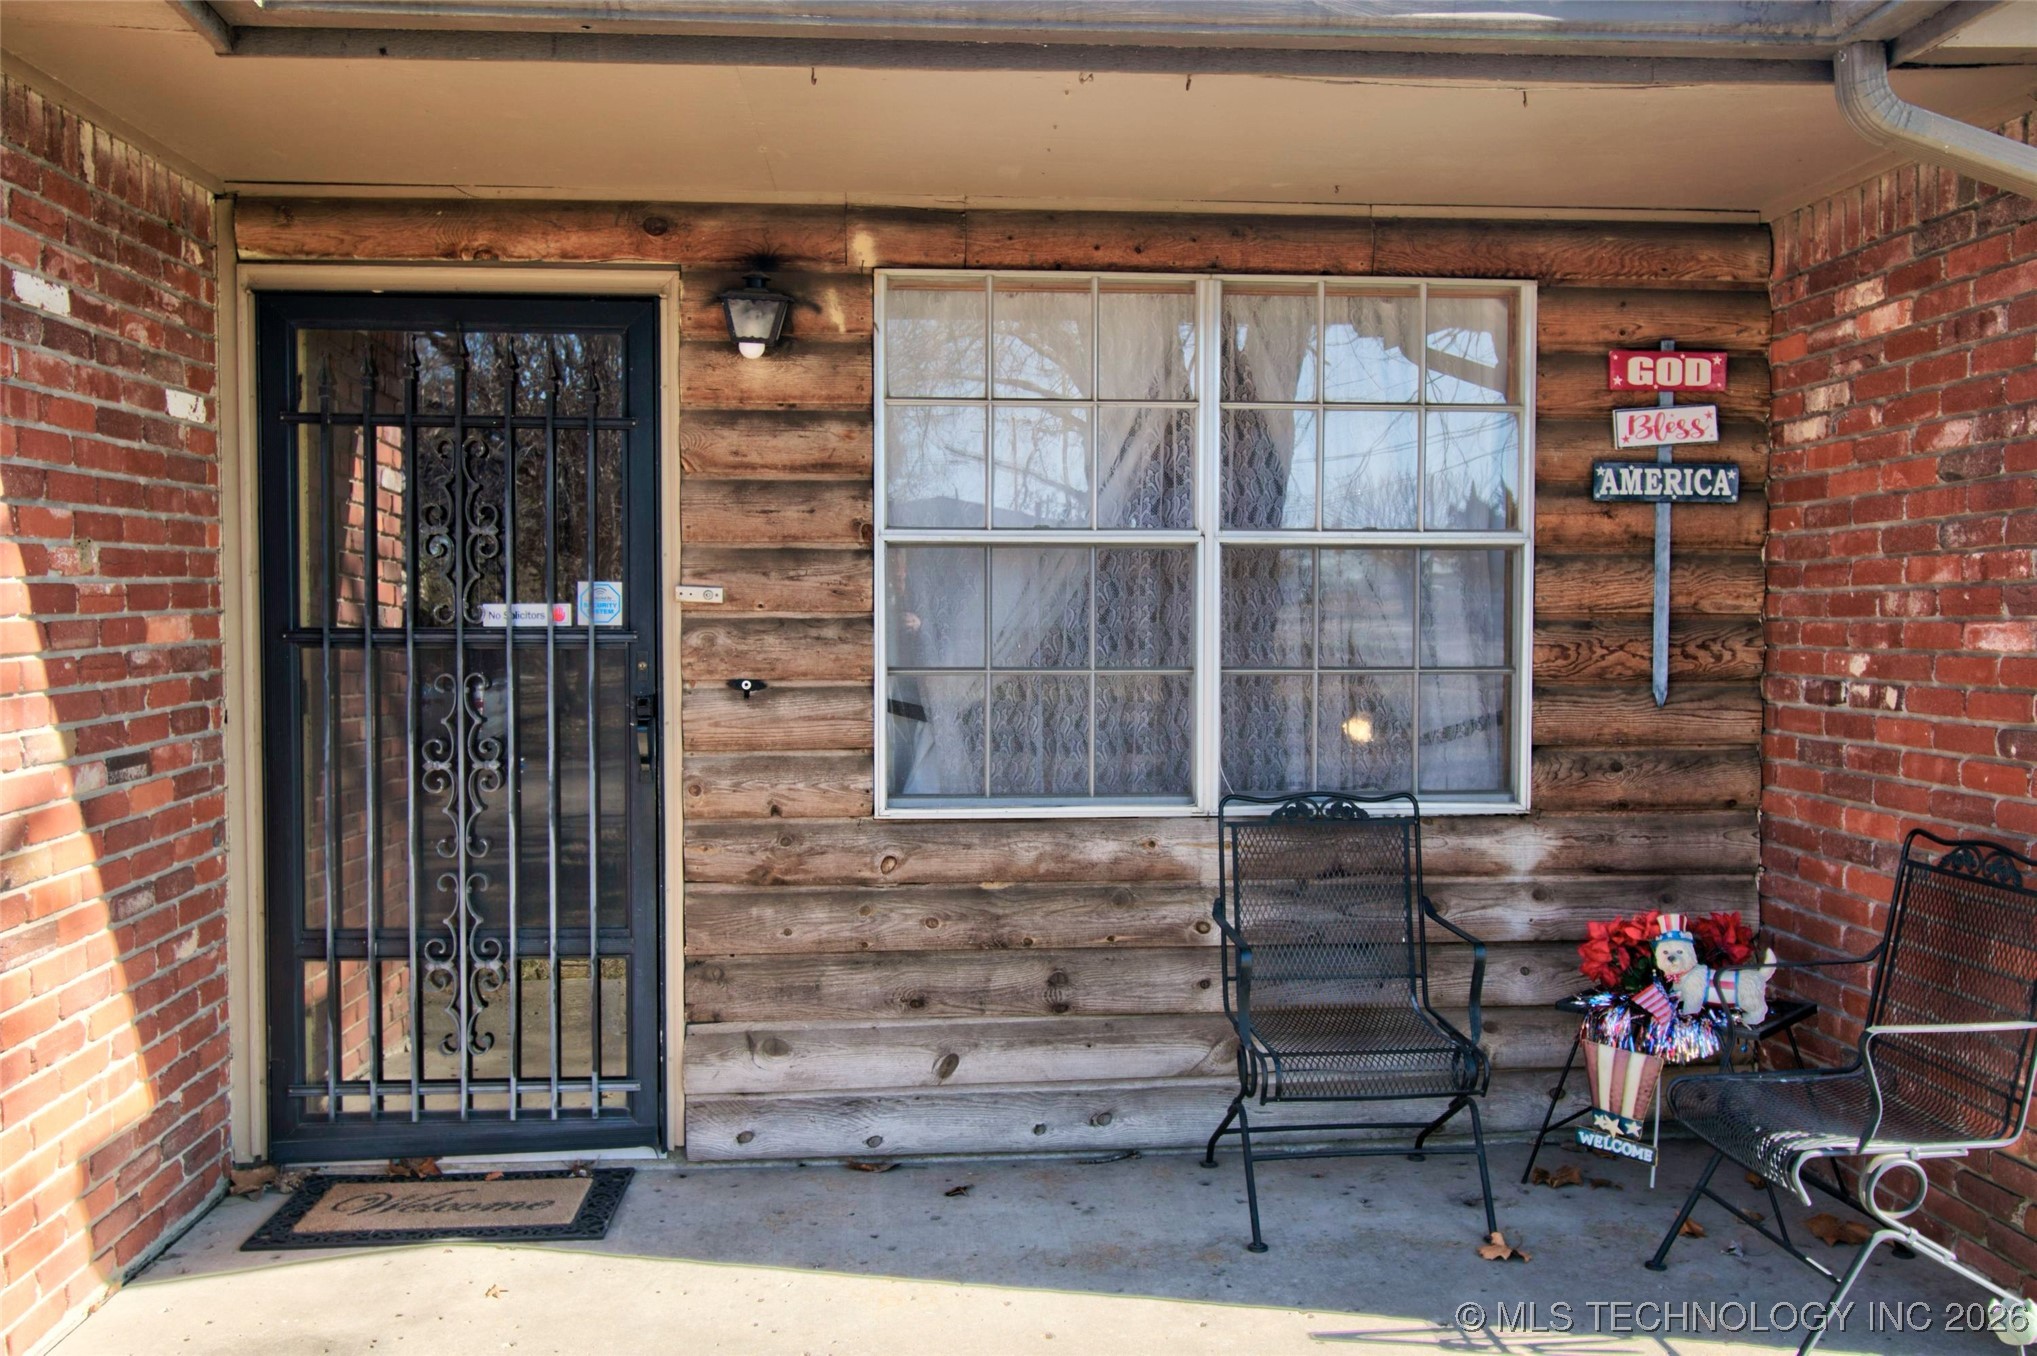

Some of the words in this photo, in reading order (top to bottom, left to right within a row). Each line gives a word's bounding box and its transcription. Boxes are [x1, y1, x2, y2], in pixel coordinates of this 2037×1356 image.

[1627, 356, 1712, 387] GOD
[1628, 411, 1710, 442] Bless
[1599, 467, 1732, 496] AMERICA
[488, 611, 502, 620] No
[1578, 1131, 1654, 1163] WELCOME
[332, 1188, 556, 1216] Welcome
